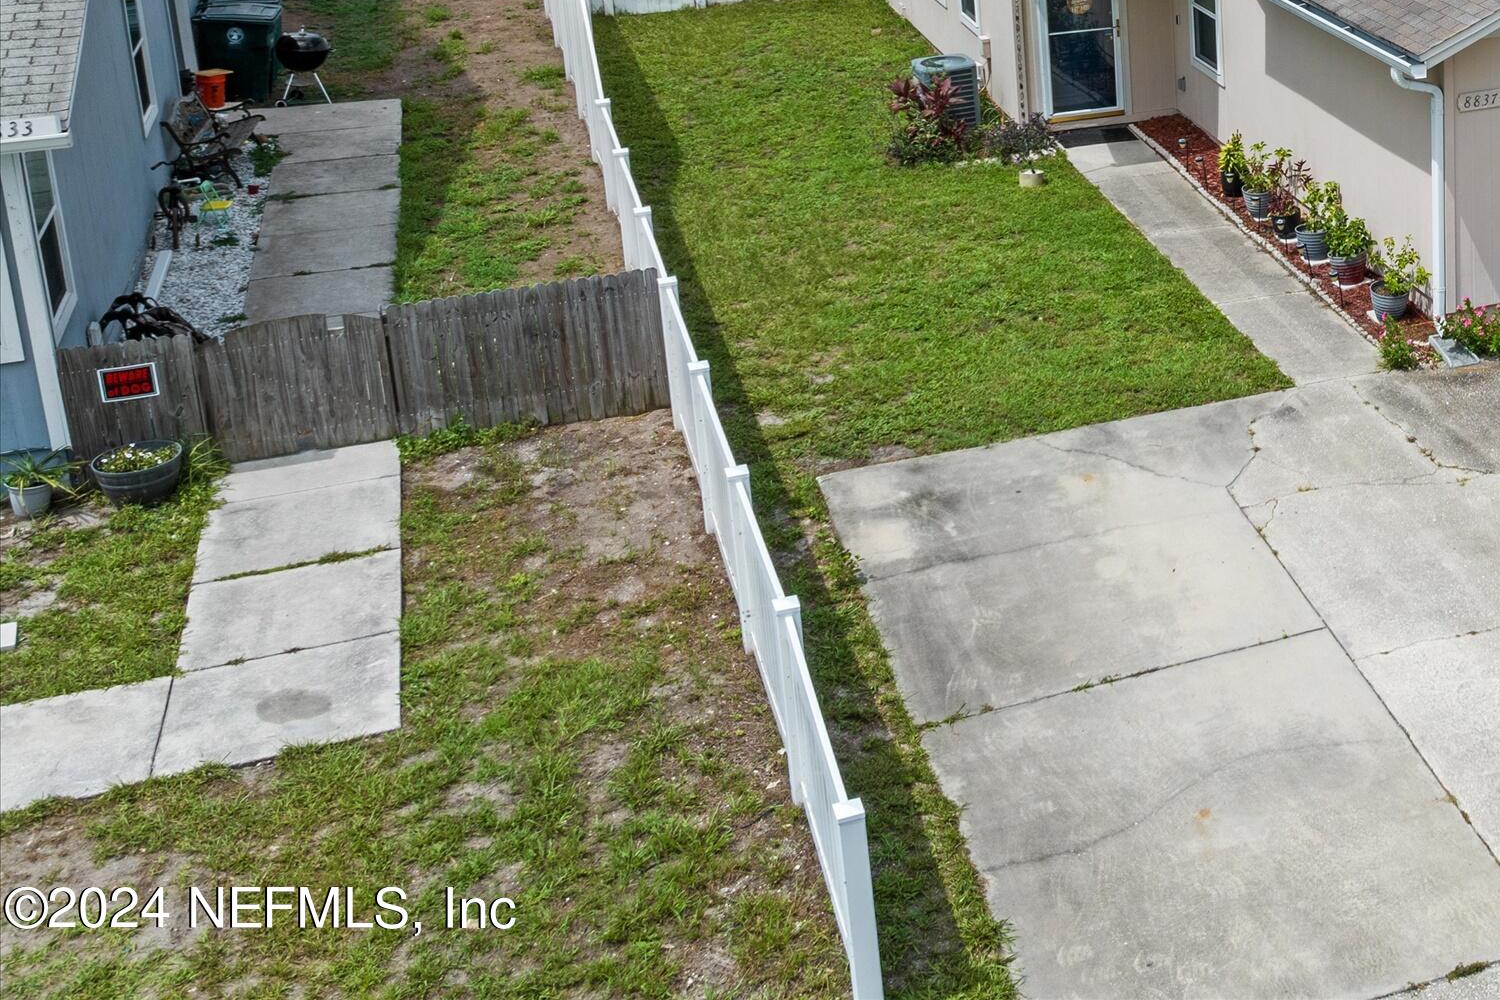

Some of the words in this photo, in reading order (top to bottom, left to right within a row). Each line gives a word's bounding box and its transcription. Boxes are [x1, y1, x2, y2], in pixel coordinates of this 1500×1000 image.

[1463, 92, 1499, 109] 8837
[0, 120, 33, 138] 33
[105, 367, 149, 384] BEWARE
[121, 381, 151, 396] DOG
